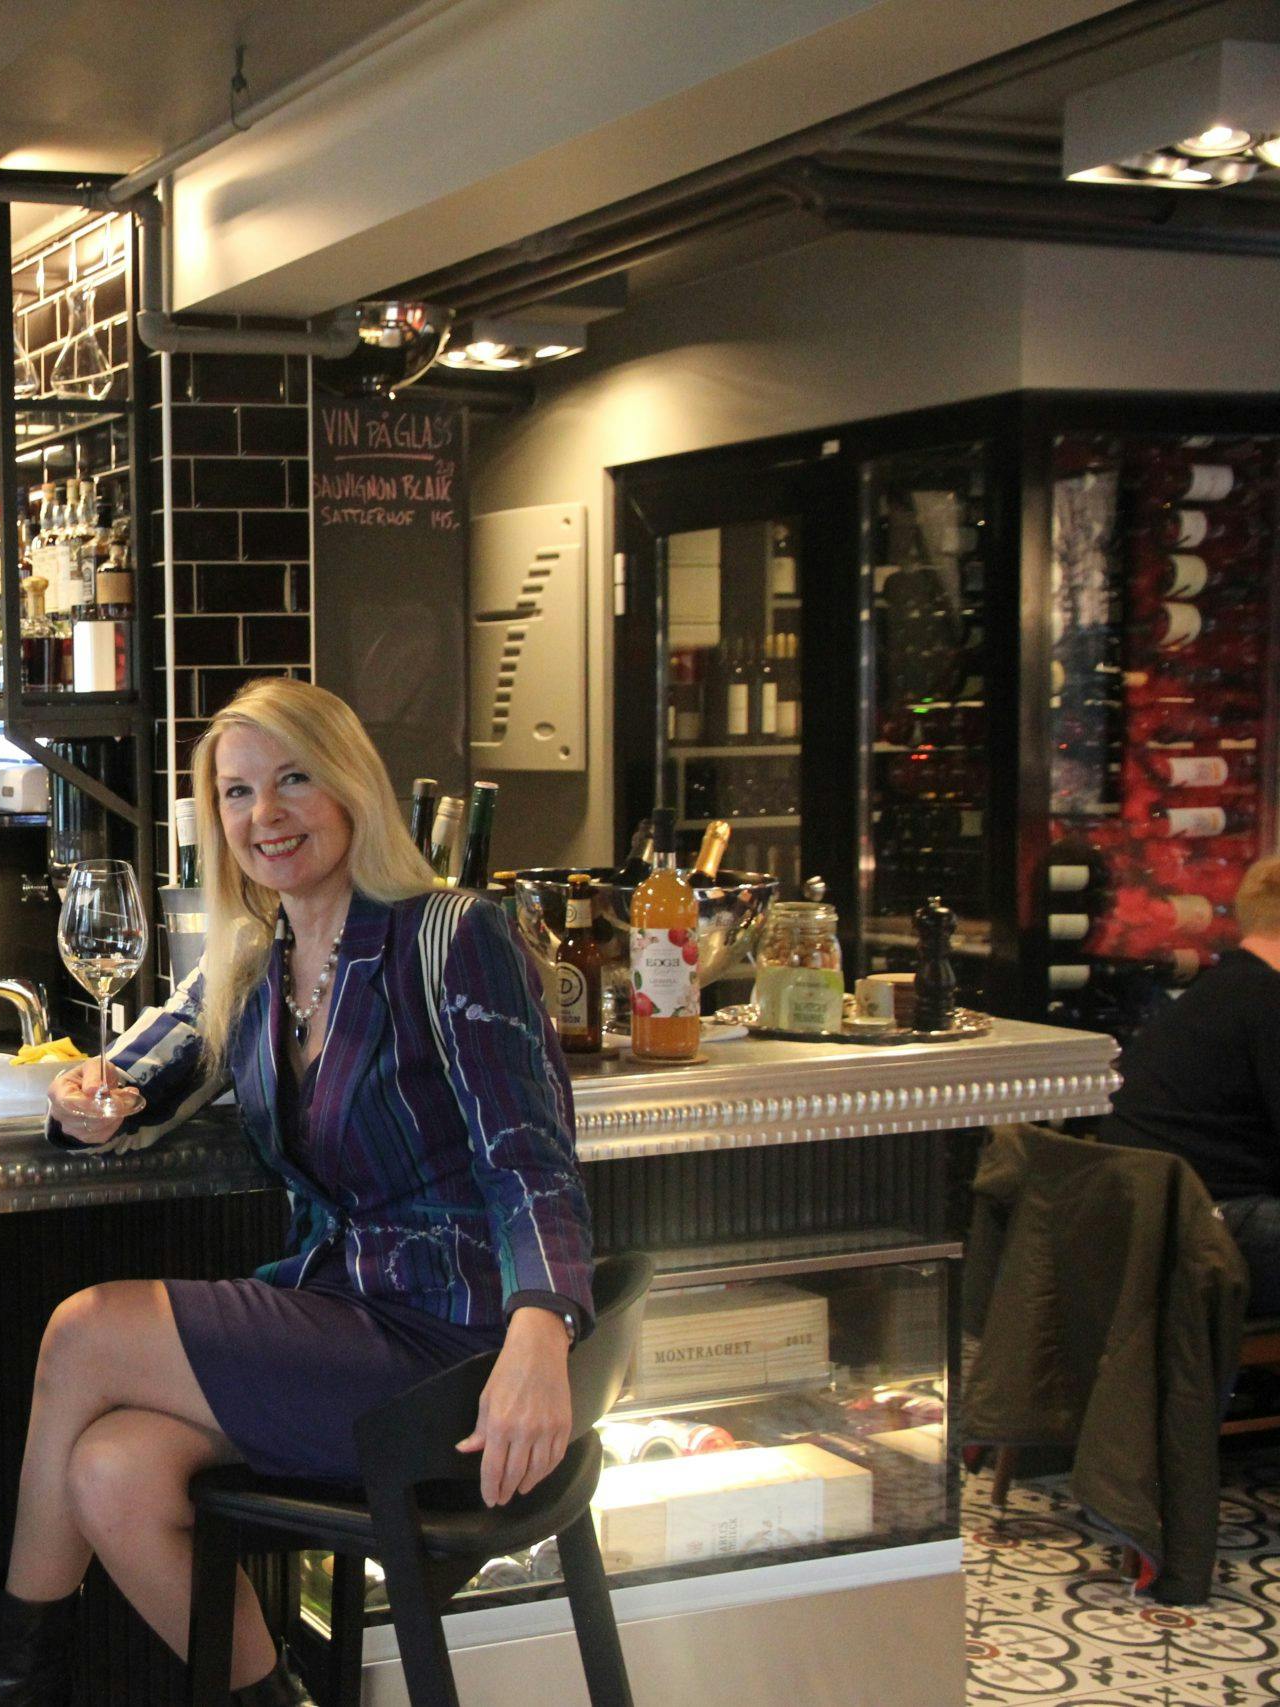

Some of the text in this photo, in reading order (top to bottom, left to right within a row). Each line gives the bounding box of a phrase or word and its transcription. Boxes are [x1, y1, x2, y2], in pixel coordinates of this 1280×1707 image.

[322, 409, 359, 446] VIN
[366, 411, 392, 448] PÅ
[655, 1340, 751, 1364] MONTRACHET
